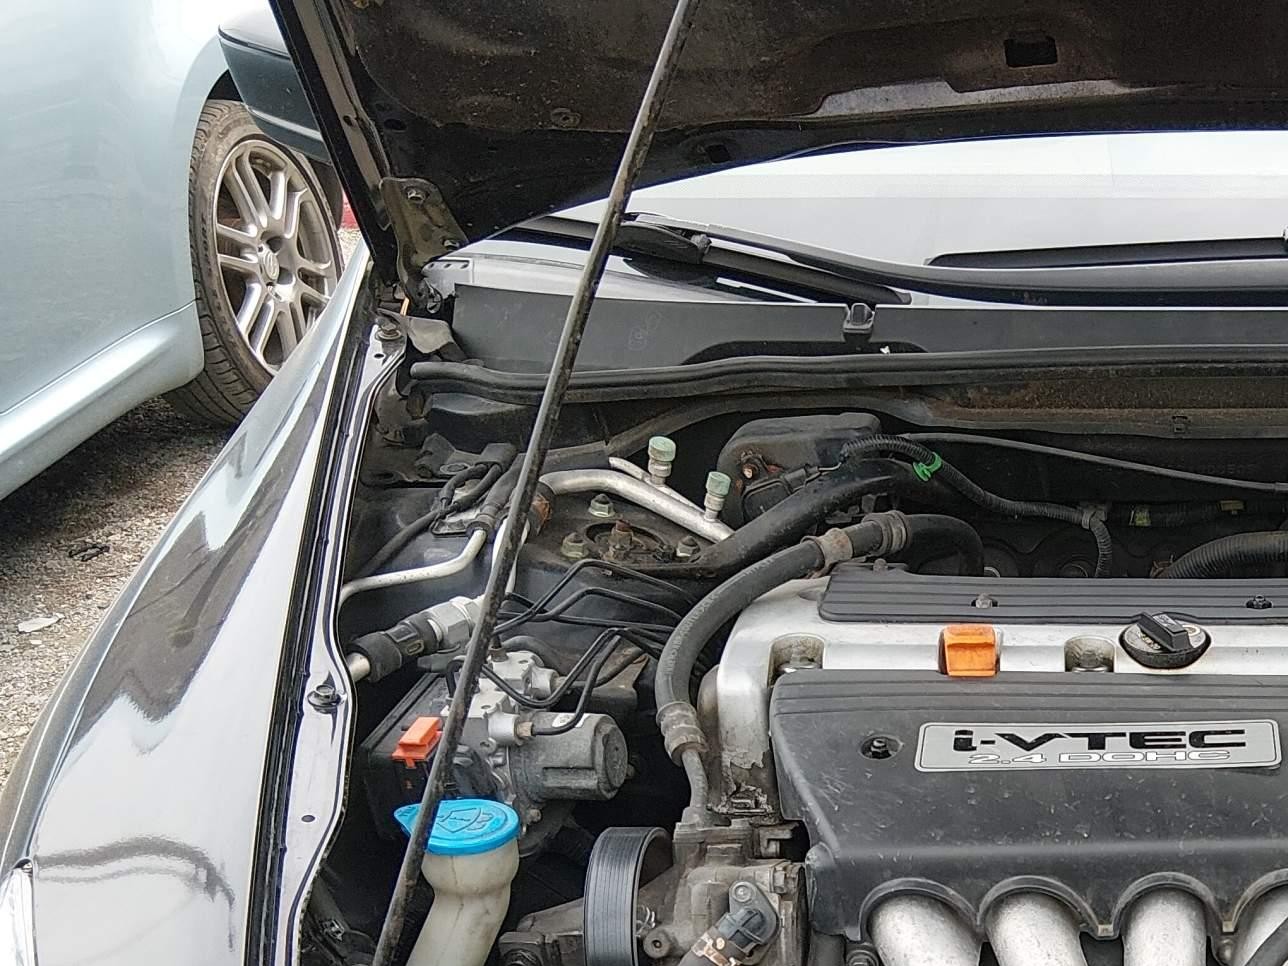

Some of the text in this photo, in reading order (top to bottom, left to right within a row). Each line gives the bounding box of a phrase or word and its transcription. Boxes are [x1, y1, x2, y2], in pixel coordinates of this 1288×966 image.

[953, 728, 1246, 753] i-VTEC
[967, 750, 1231, 765] 2.4 DOHC
